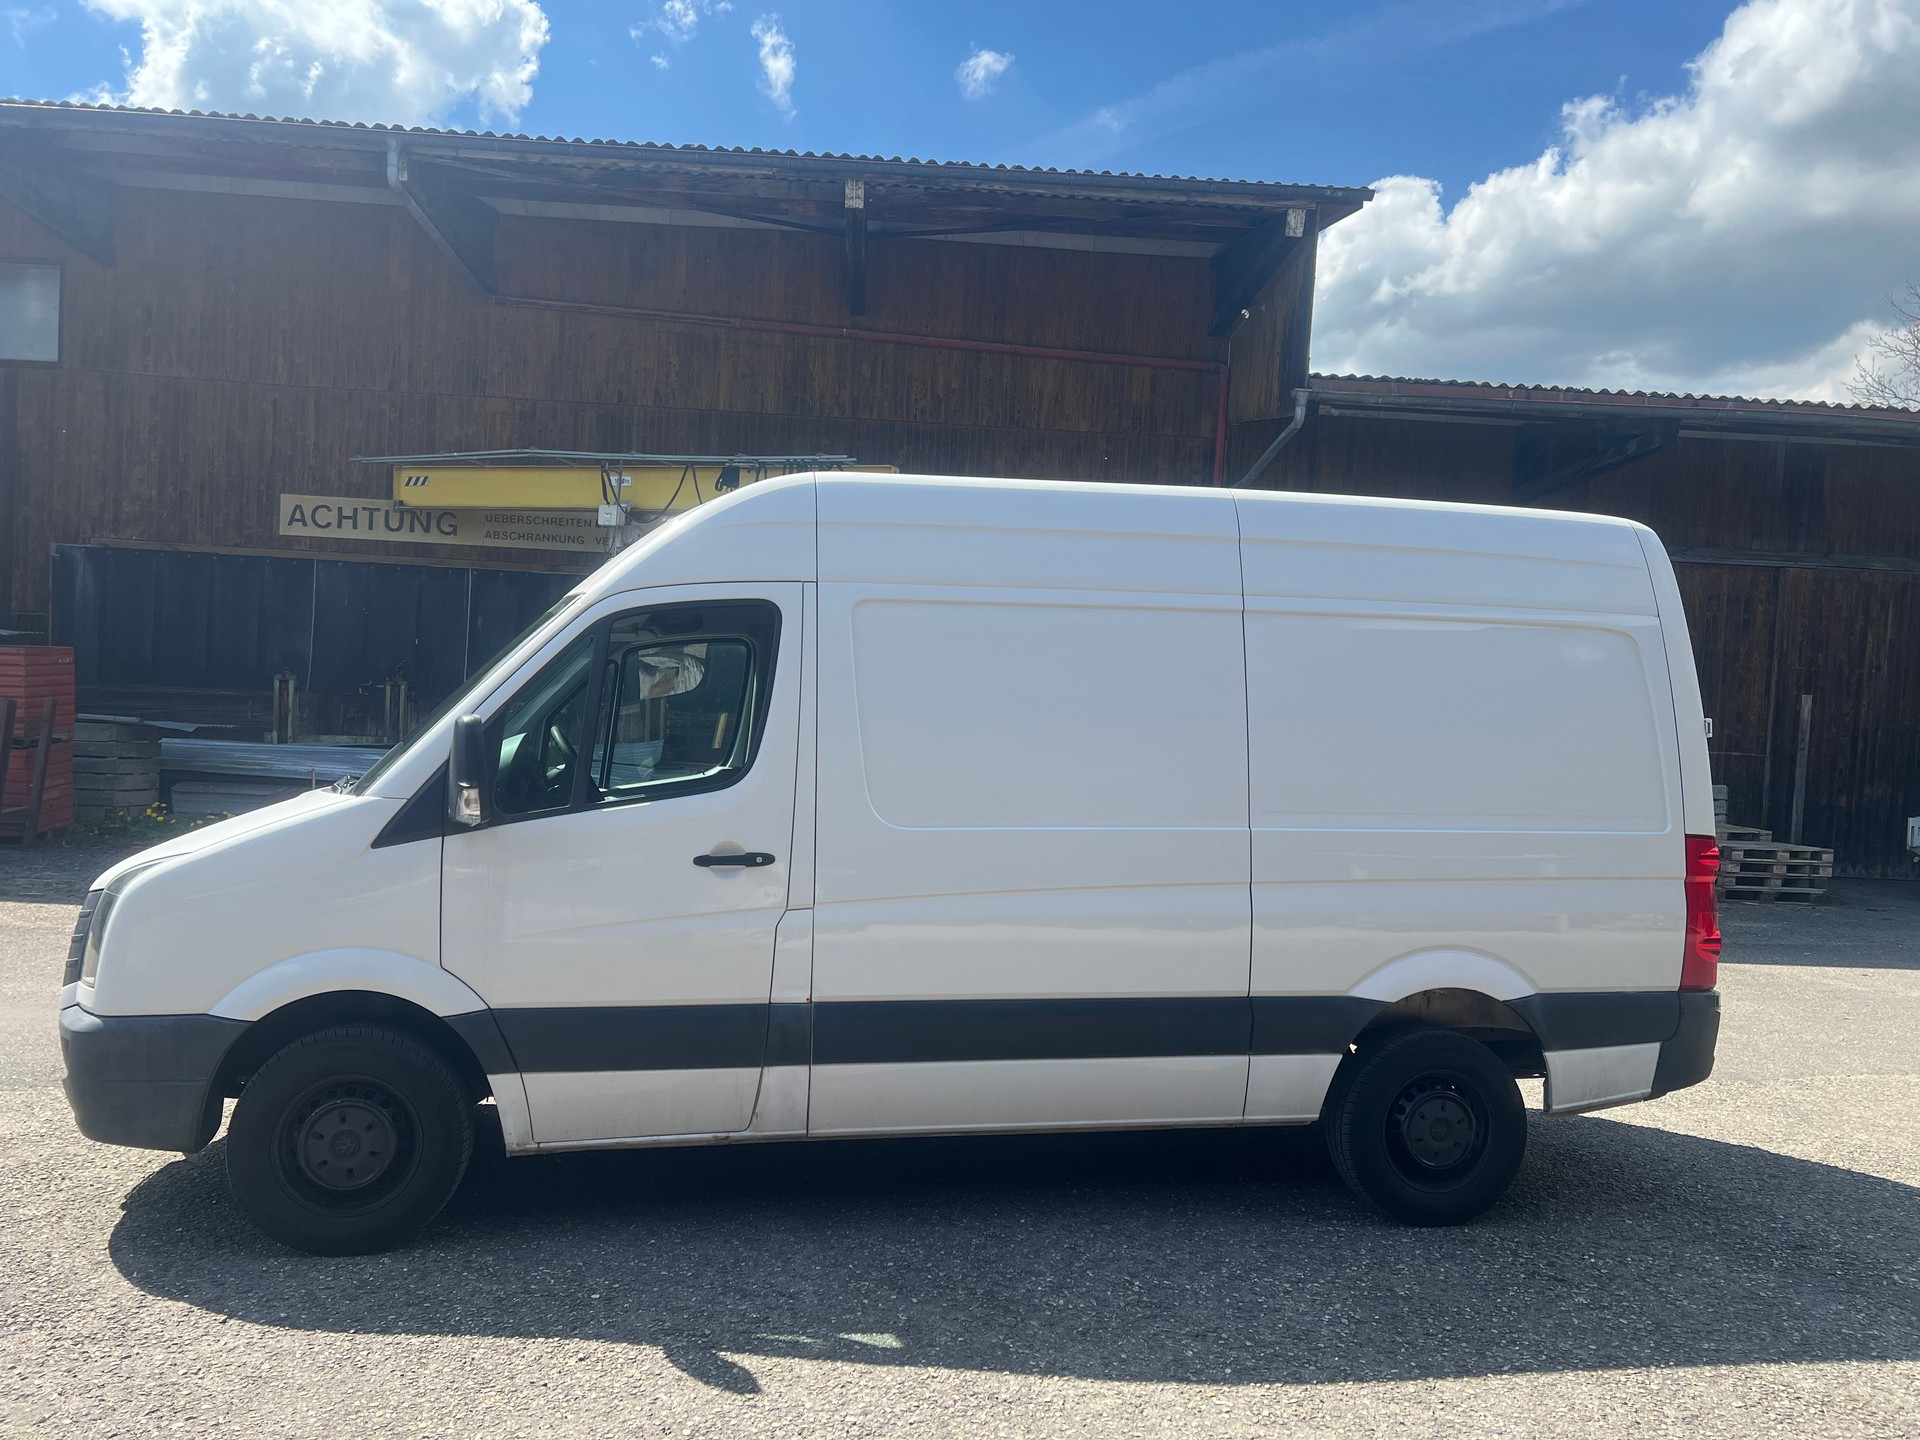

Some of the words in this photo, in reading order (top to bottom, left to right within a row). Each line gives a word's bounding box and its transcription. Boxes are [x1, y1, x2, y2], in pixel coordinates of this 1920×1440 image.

[287, 504, 458, 537] ACHTUNG
[485, 513, 592, 528] UEBERSCHREITEN
[484, 531, 585, 545] ABSCHRANKUNG
[595, 536, 609, 546] VE
